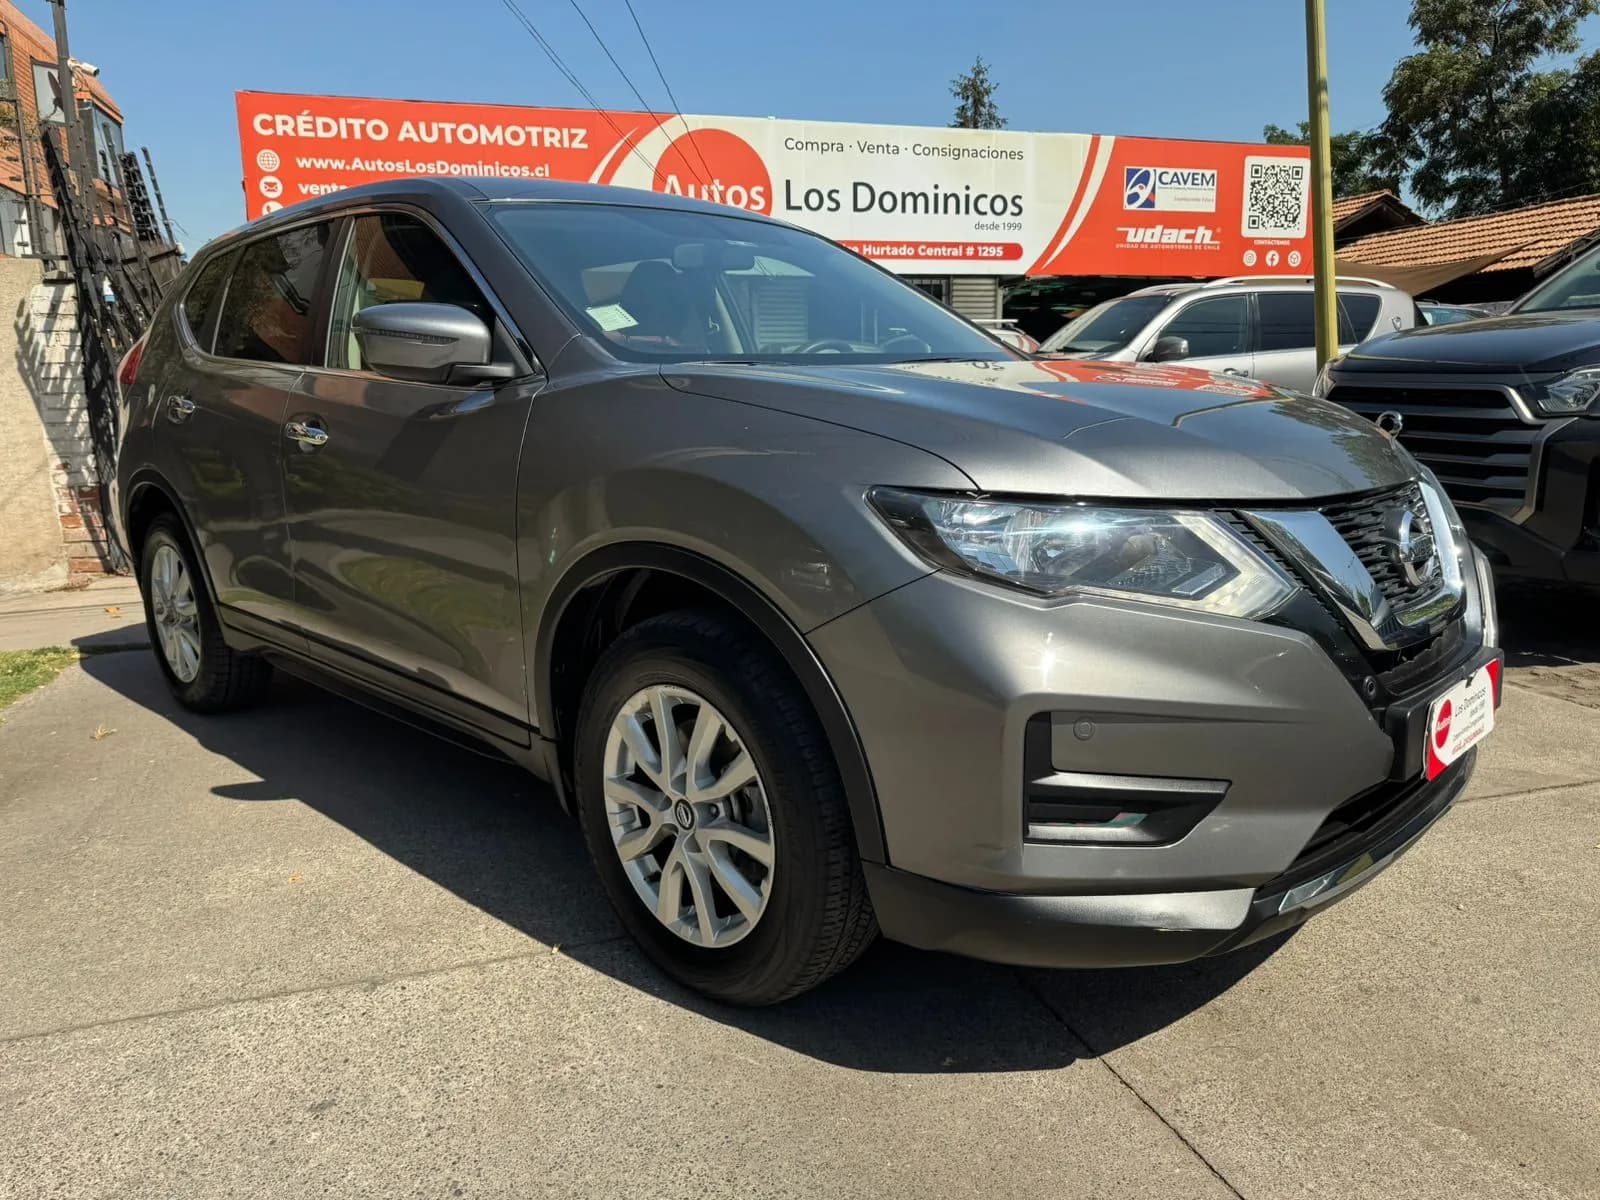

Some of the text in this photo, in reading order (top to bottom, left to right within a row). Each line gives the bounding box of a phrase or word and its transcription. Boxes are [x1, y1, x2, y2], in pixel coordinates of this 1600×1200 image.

[253, 110, 589, 149] CRÉDITO AUTOMOTRIZ
[784, 137, 1024, 161] Compra Venta Consignaciones
[296, 156, 550, 177] www.AutosLosDominicos.cl
[1158, 171, 1215, 187] CAVEM
[663, 174, 766, 211] Autos
[785, 179, 1024, 217] Los Dominicos
[974, 221, 1022, 231] desde 1999
[1116, 225, 1221, 244] udach
[863, 244, 914, 257] Hurtado
[918, 245, 963, 257] Central
[978, 246, 1003, 257] 1295
